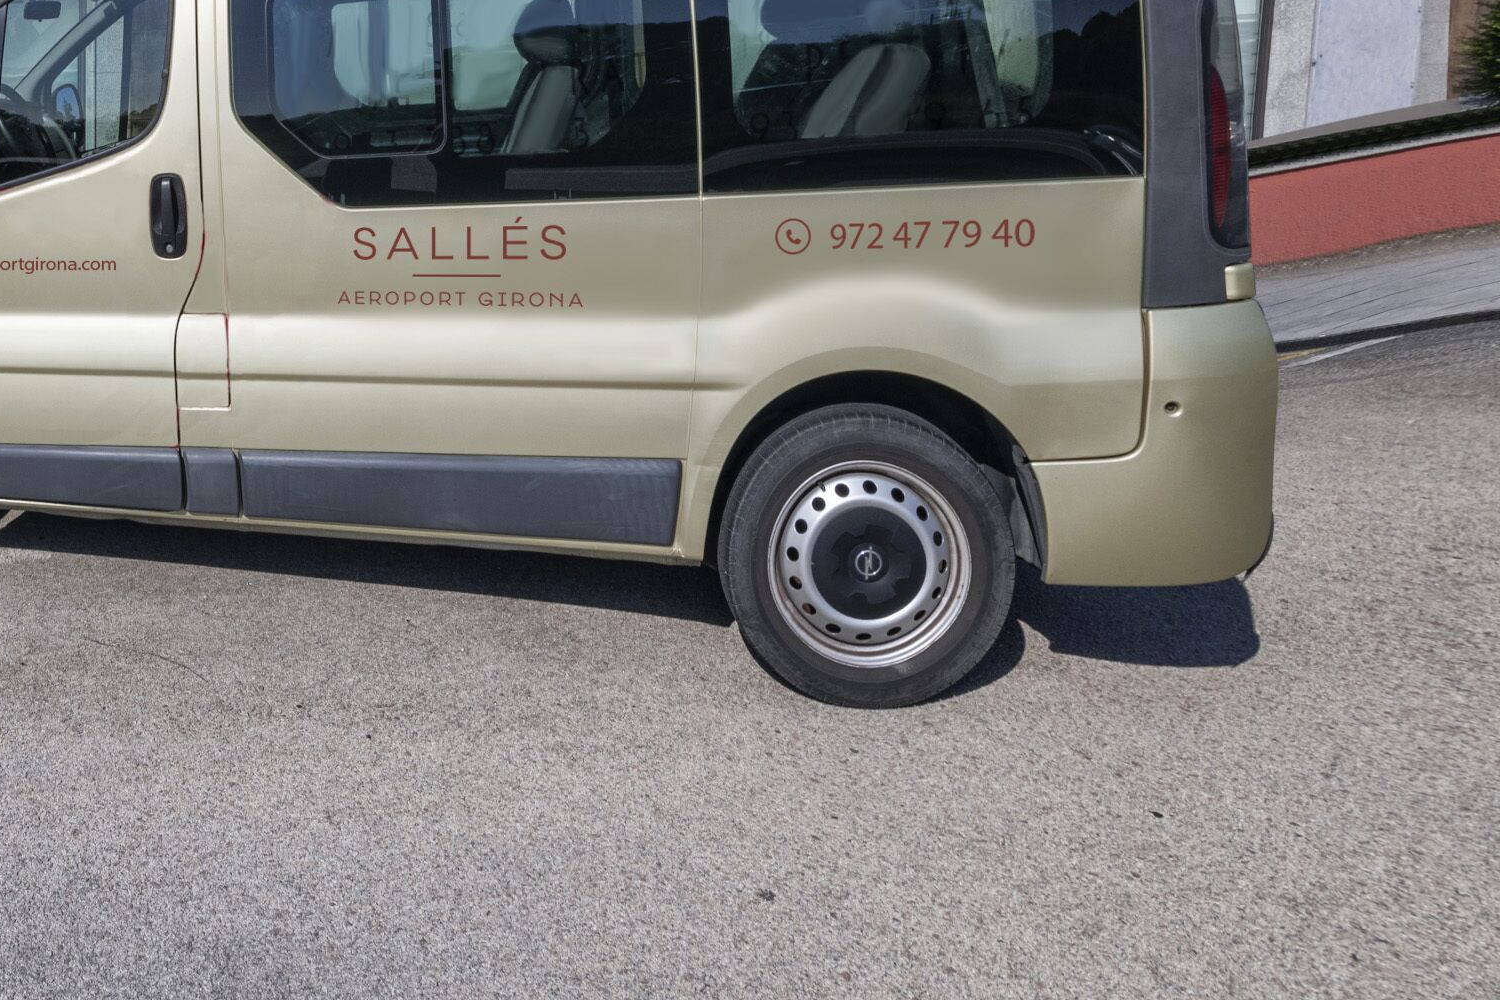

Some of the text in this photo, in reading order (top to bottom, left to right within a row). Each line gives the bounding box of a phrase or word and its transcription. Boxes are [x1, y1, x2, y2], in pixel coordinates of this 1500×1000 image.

[352, 216, 568, 261] SALLÉS
[829, 218, 1036, 250] 972 47 79 40
[337, 290, 584, 308] AEROPORT GIRONA
